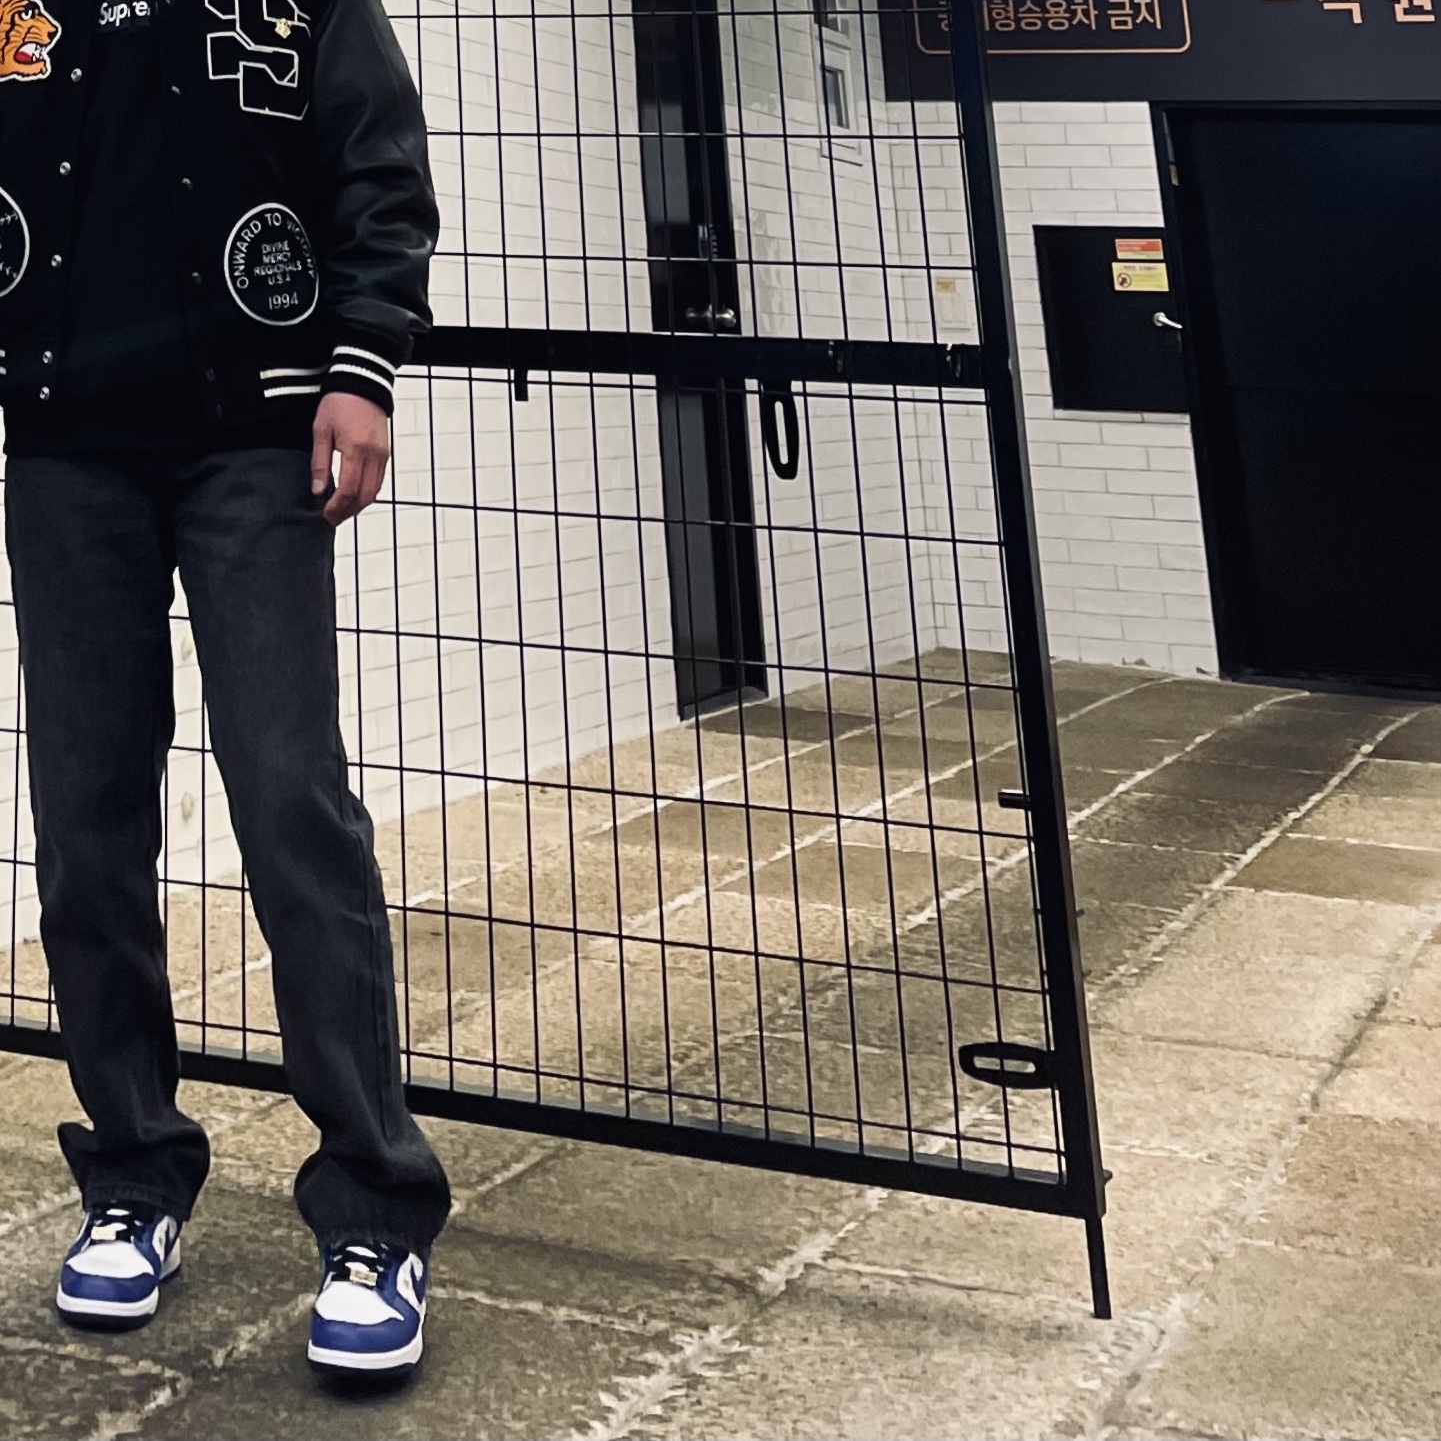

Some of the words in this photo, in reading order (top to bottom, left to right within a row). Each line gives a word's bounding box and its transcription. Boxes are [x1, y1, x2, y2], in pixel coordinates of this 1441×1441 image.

[232, 220, 262, 289] ONWARD
[264, 212, 282, 227] TO
[268, 291, 299, 310] 1994
